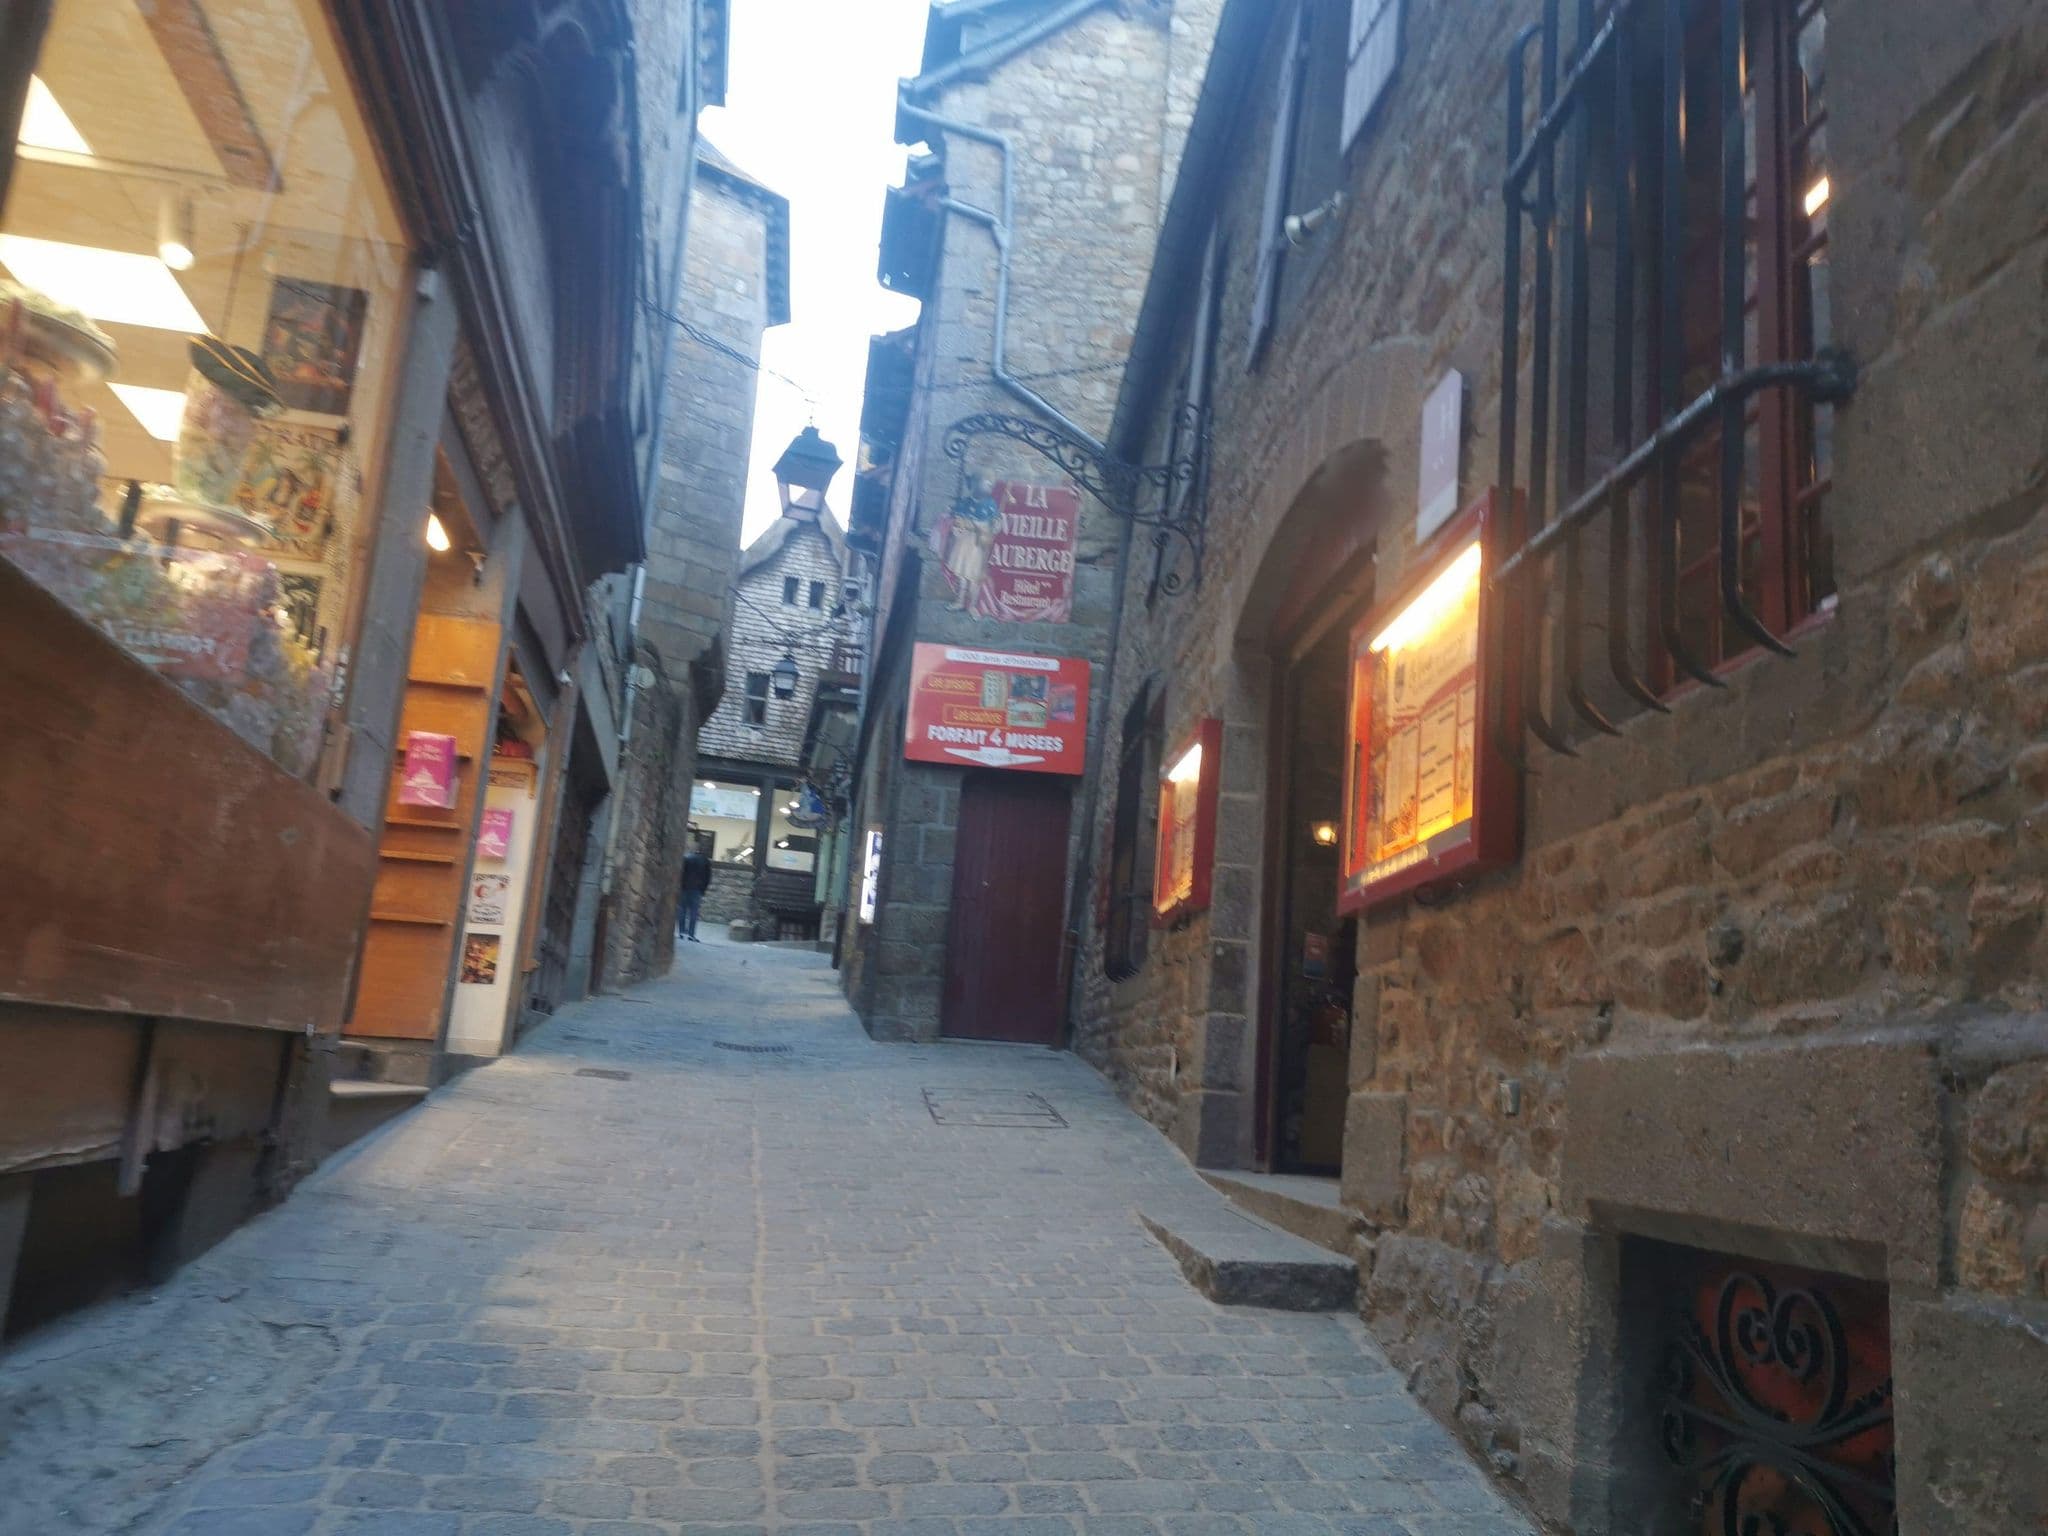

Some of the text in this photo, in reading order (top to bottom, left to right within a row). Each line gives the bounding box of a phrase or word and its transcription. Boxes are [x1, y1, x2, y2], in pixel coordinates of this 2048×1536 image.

[1025, 484, 1049, 509] LA
[1000, 512, 1068, 542] VIEILLE
[988, 543, 1072, 574] AUBERGE
[928, 724, 1064, 752] FORFAIT 4 MUSEES
